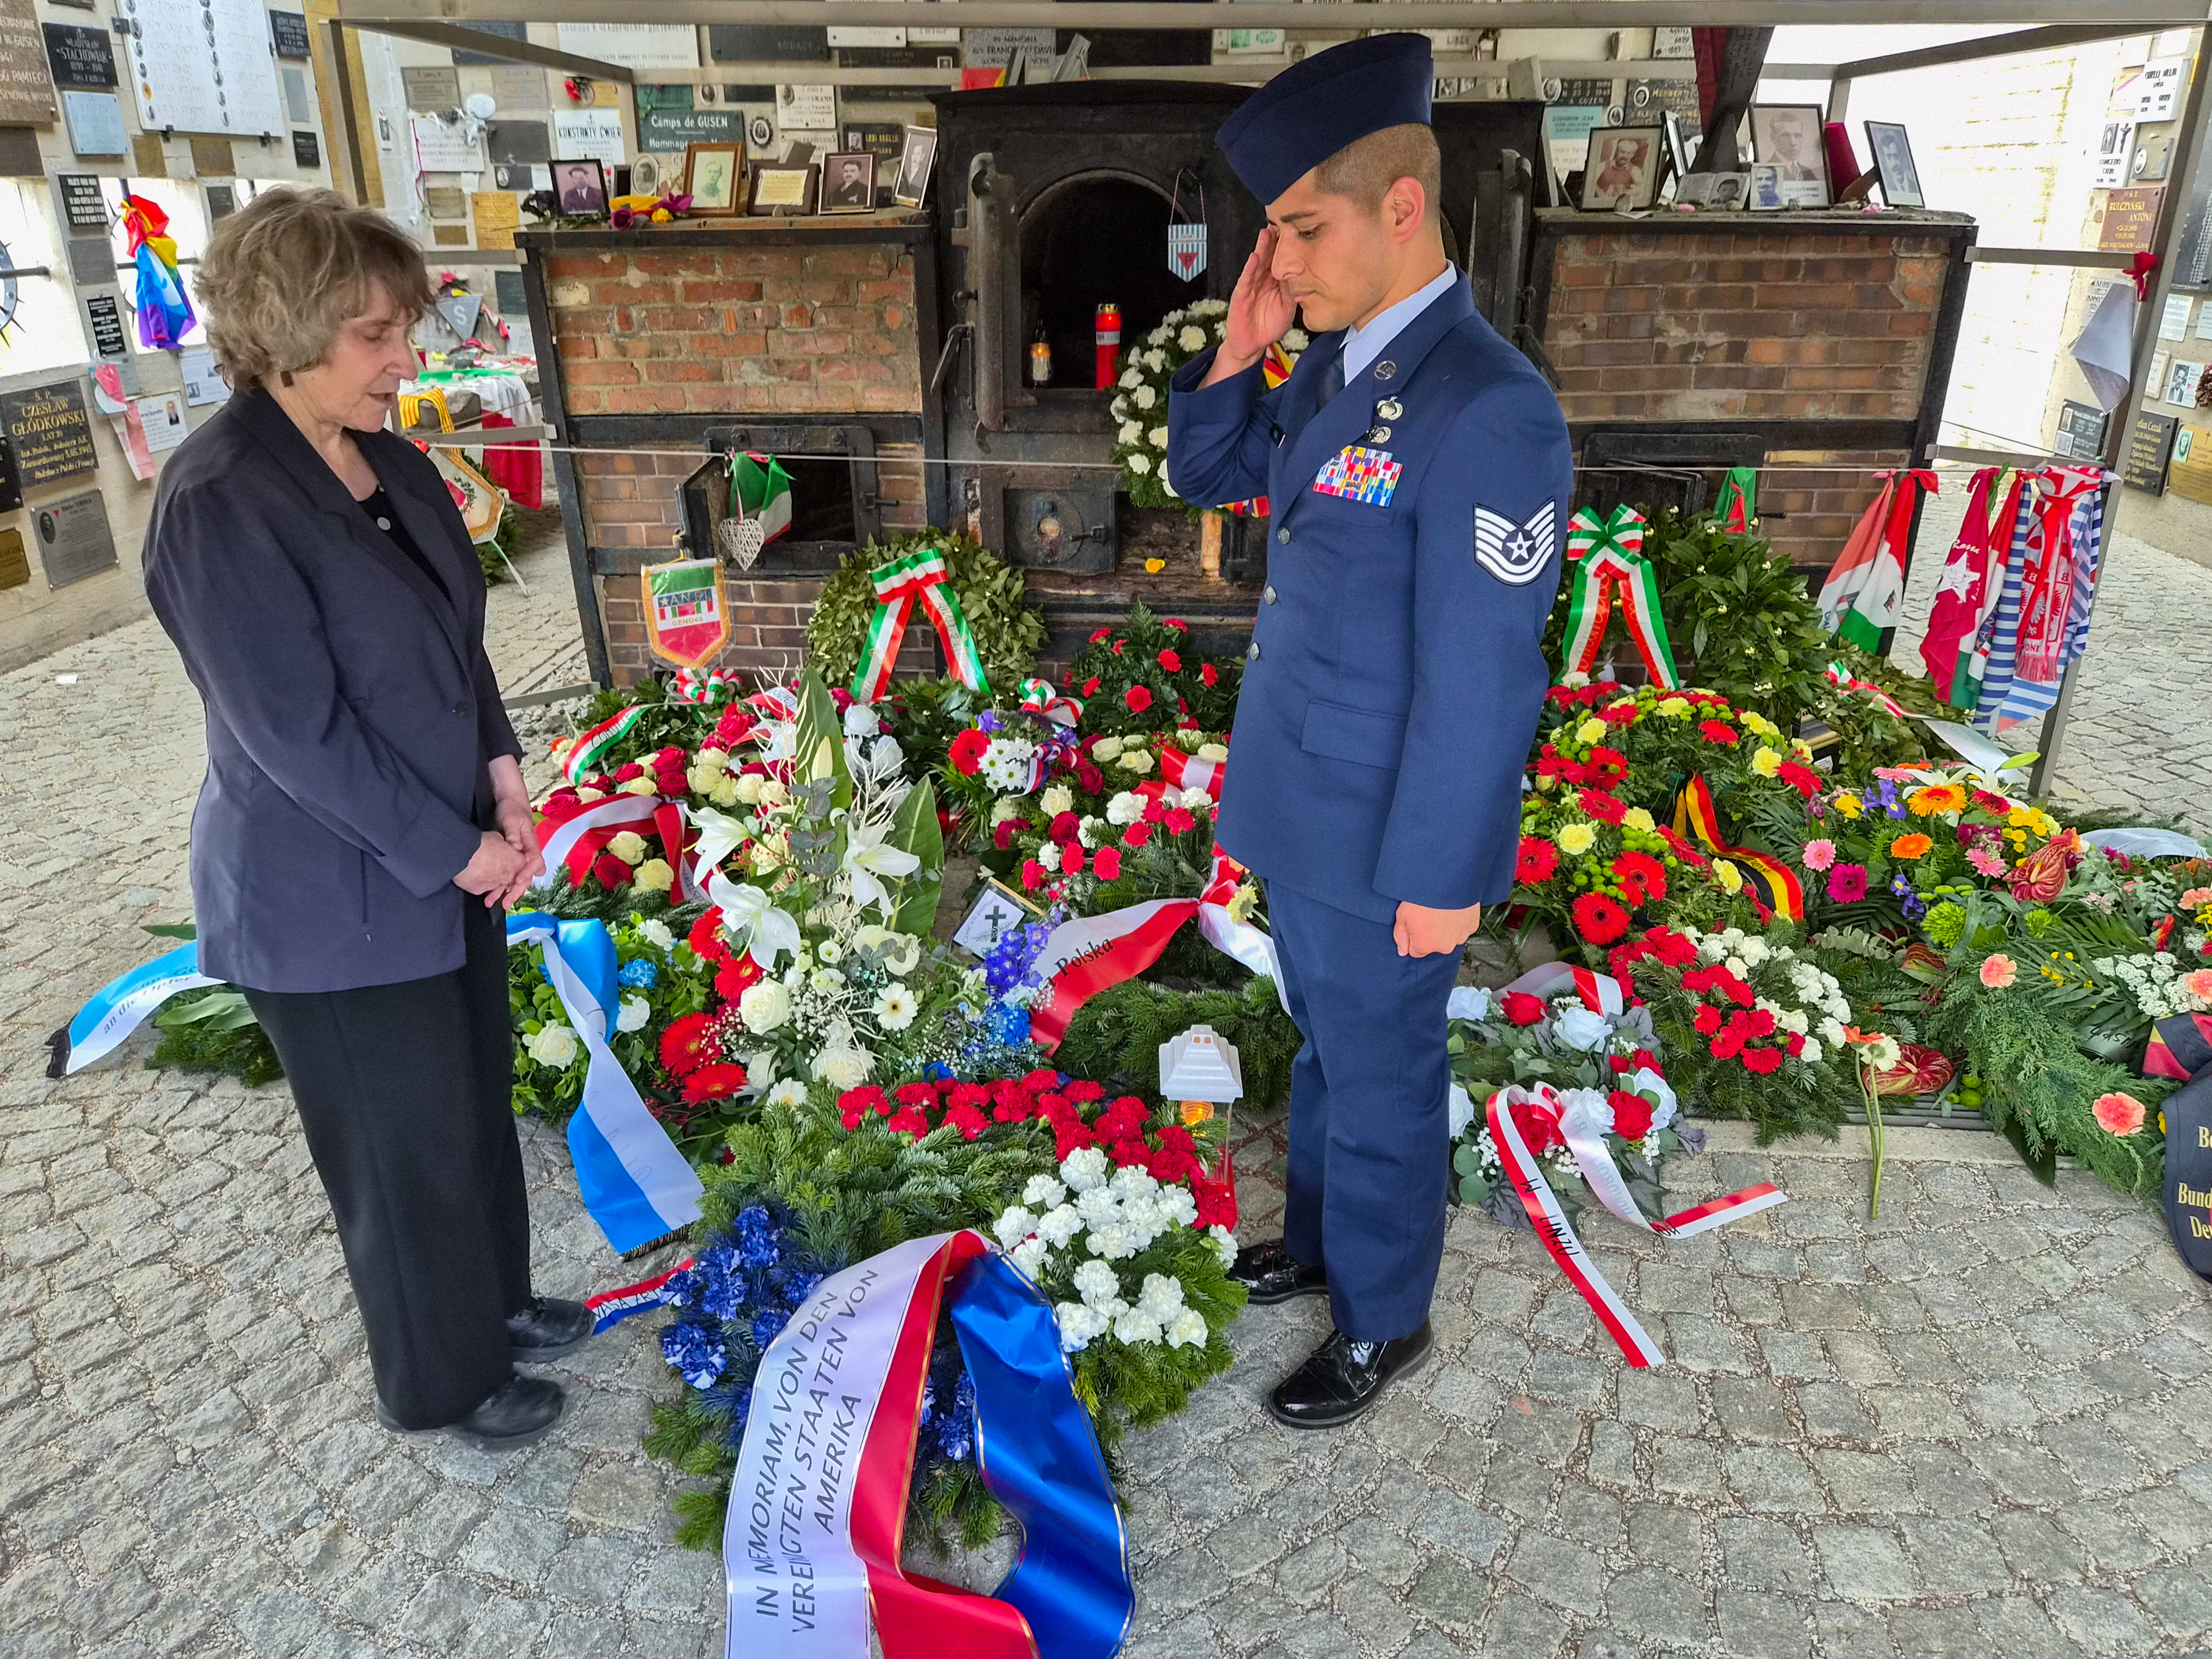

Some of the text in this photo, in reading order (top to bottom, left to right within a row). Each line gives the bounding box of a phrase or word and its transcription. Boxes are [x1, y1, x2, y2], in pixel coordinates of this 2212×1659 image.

[651, 115, 728, 129] Camps de GUSEN
[1185, 255, 1192, 266] P
[454, 304, 467, 326] S
[12, 409, 86, 437] GŁÓDKOWSKI
[672, 615, 704, 627] GENOVA
[1053, 936, 1115, 979] Polska
[104, 1015, 117, 1034] an
[118, 997, 138, 1016] die
[1539, 1212, 1580, 1257] LINZU
[793, 1327, 848, 1472] STAATEN
[837, 1269, 879, 1319] VON
[756, 1586, 779, 1618] IN
[773, 1346, 808, 1414] VON
[799, 1291, 838, 1344] DEN
[814, 1394, 862, 1536] AMERIKA
